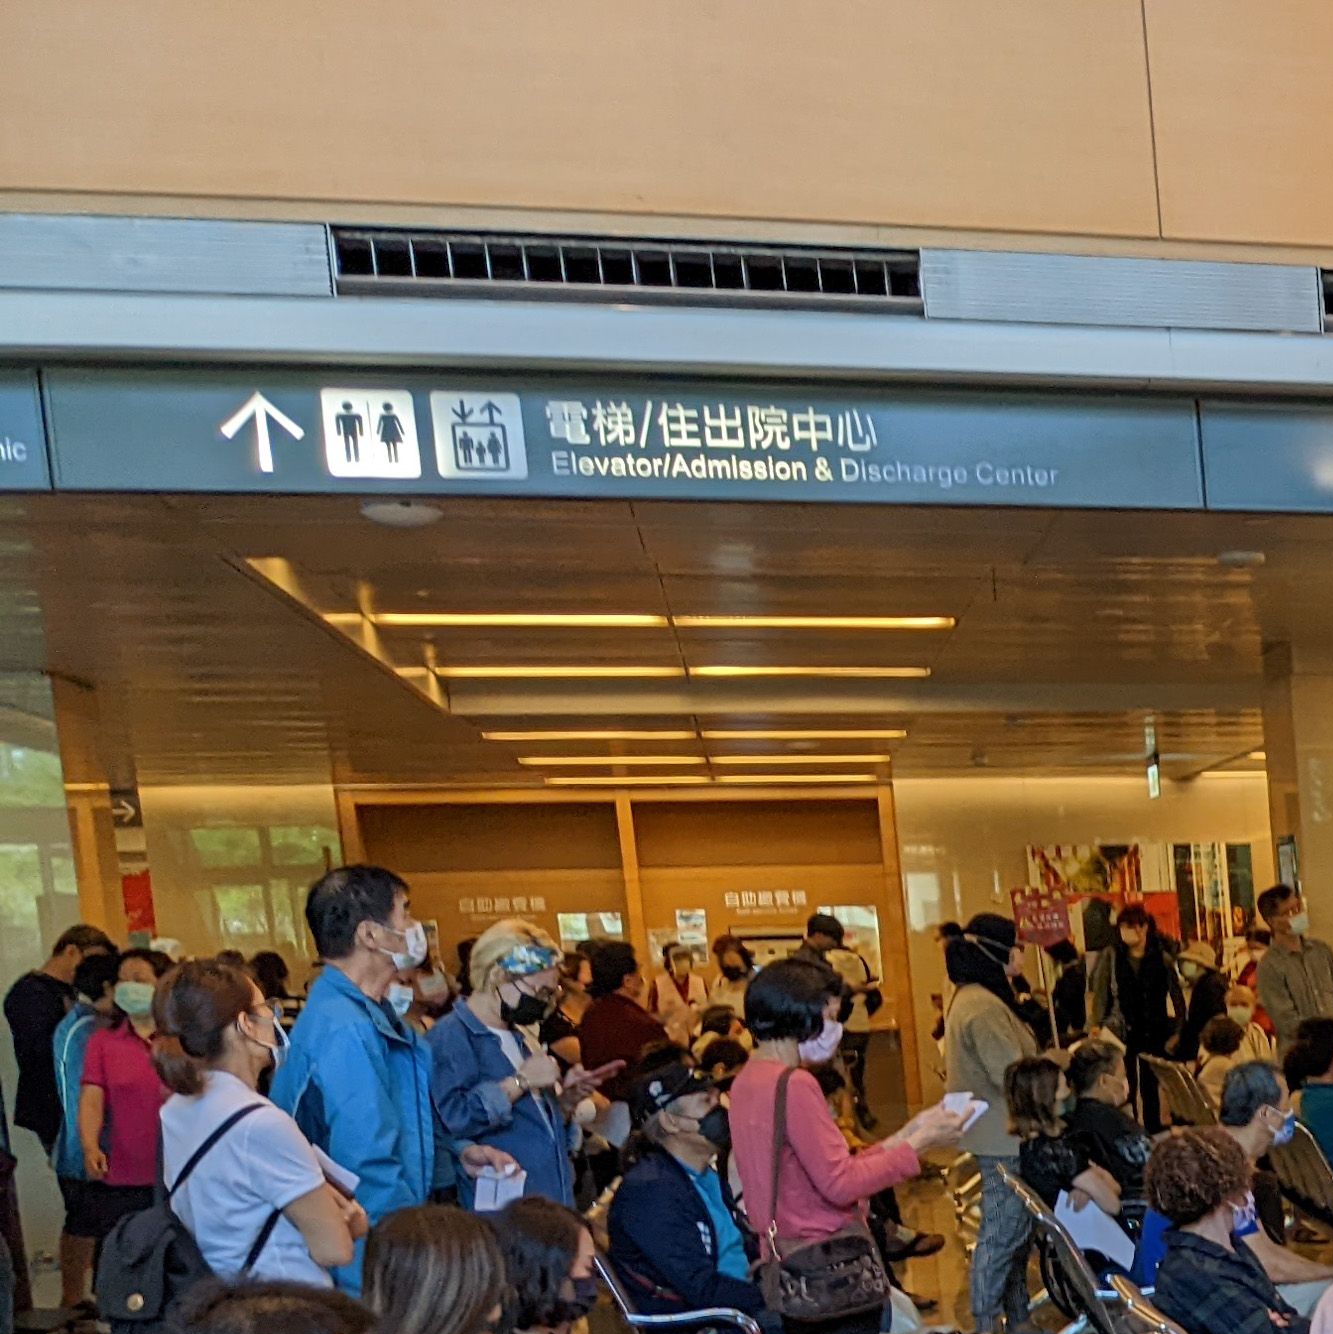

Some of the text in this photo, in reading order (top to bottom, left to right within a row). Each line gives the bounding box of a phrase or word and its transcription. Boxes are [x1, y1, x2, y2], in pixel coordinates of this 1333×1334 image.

[548, 401, 878, 450] 電梯/住出院中心
[551, 450, 1059, 487] Elevator/Admission & Discharge Center
